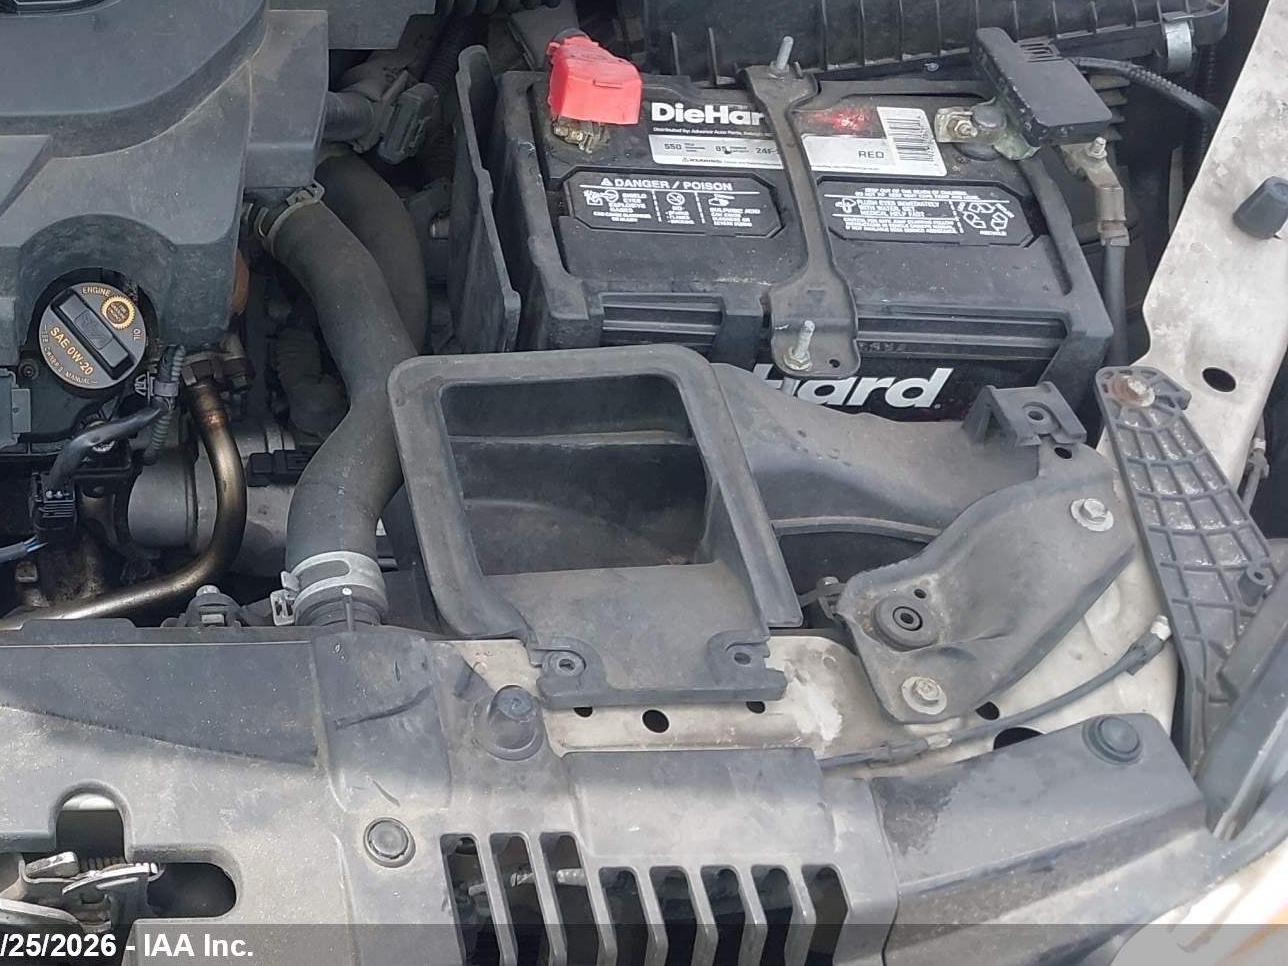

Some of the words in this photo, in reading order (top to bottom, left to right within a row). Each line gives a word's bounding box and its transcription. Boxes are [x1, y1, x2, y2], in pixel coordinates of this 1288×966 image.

[651, 102, 765, 125] DieHar
[858, 151, 884, 159] RED
[614, 178, 669, 189] DANGER
[683, 180, 733, 191] POISON
[82, 286, 111, 297] ENGINE
[133, 328, 141, 341] OIL
[50, 327, 70, 348] SAE
[67, 346, 94, 375] 0W-20
